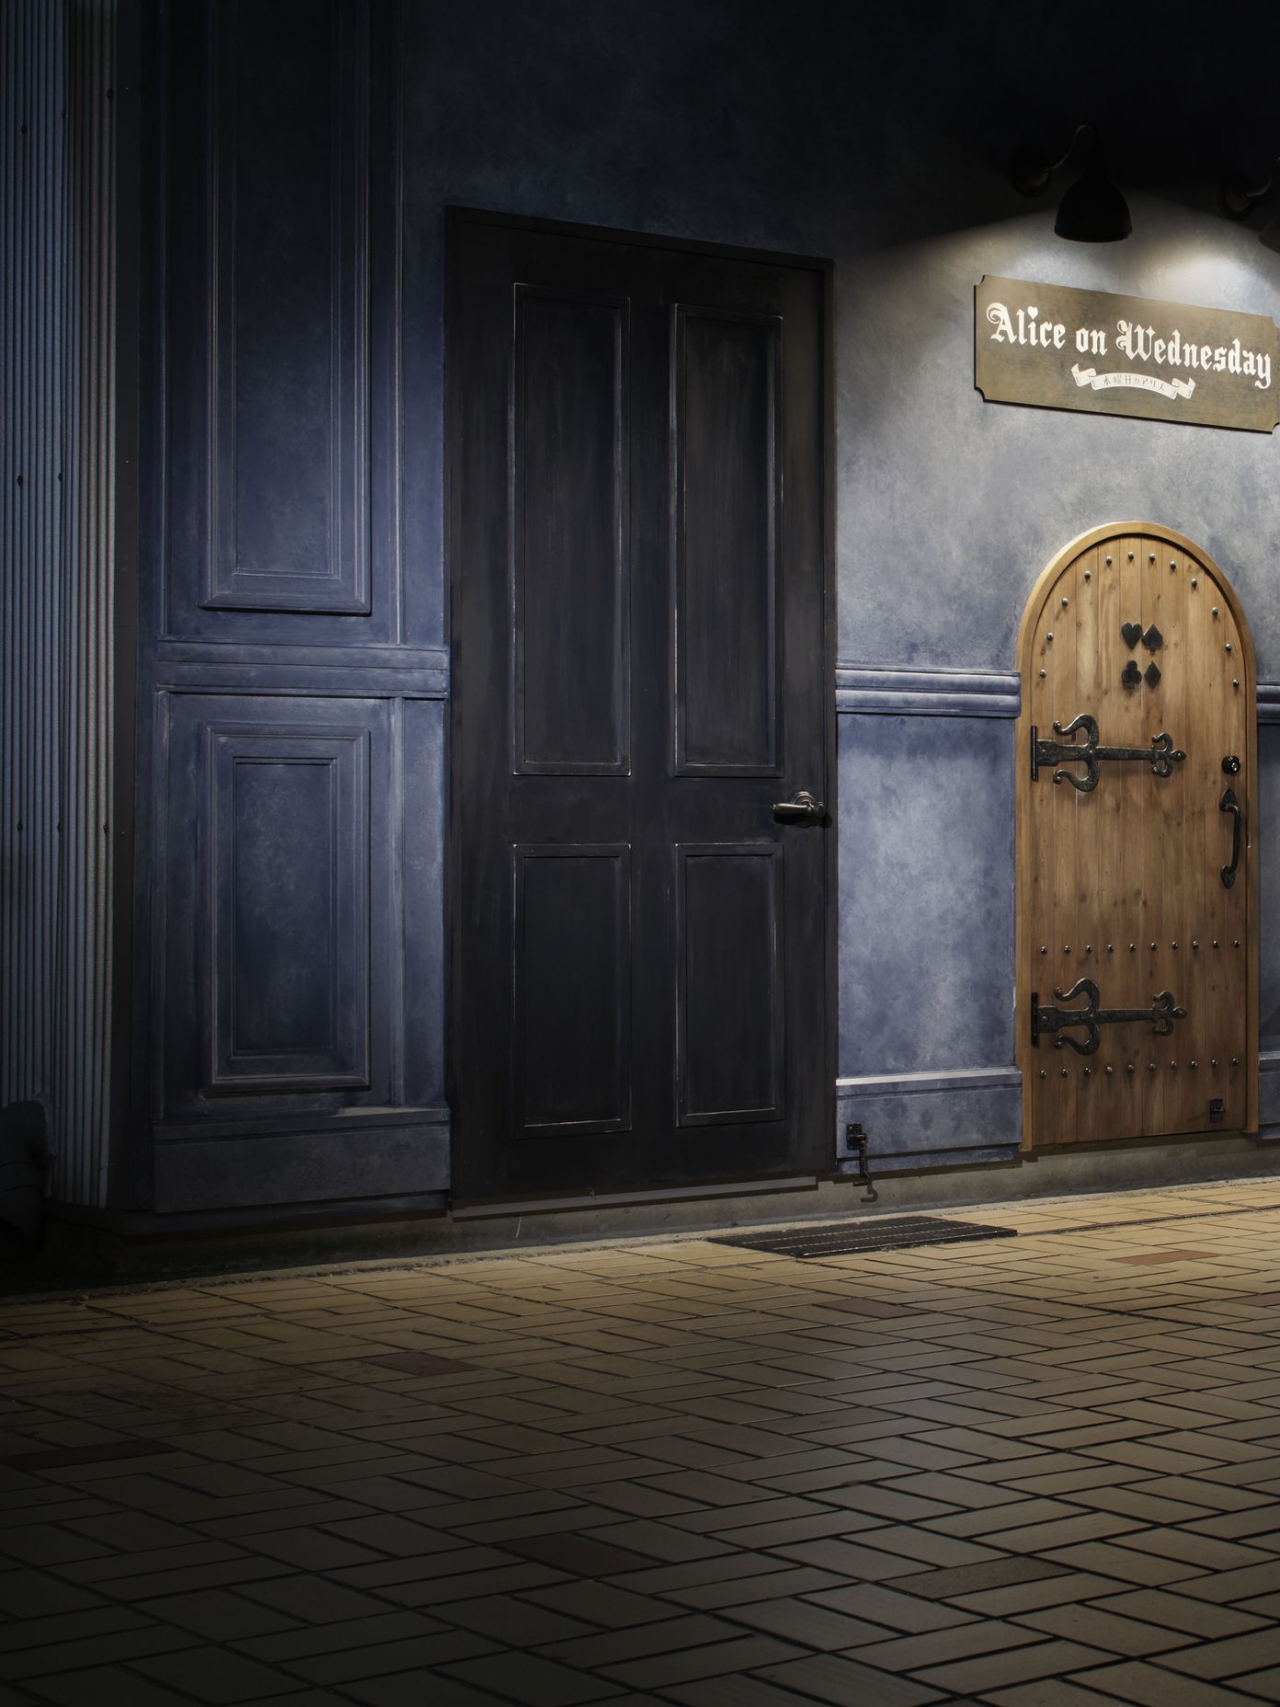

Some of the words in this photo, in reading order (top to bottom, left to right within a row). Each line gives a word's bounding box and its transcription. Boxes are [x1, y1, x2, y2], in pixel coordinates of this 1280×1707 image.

[986, 302, 1067, 350] Alice
[1075, 325, 1108, 356] on
[1116, 319, 1272, 389] Wednesday
